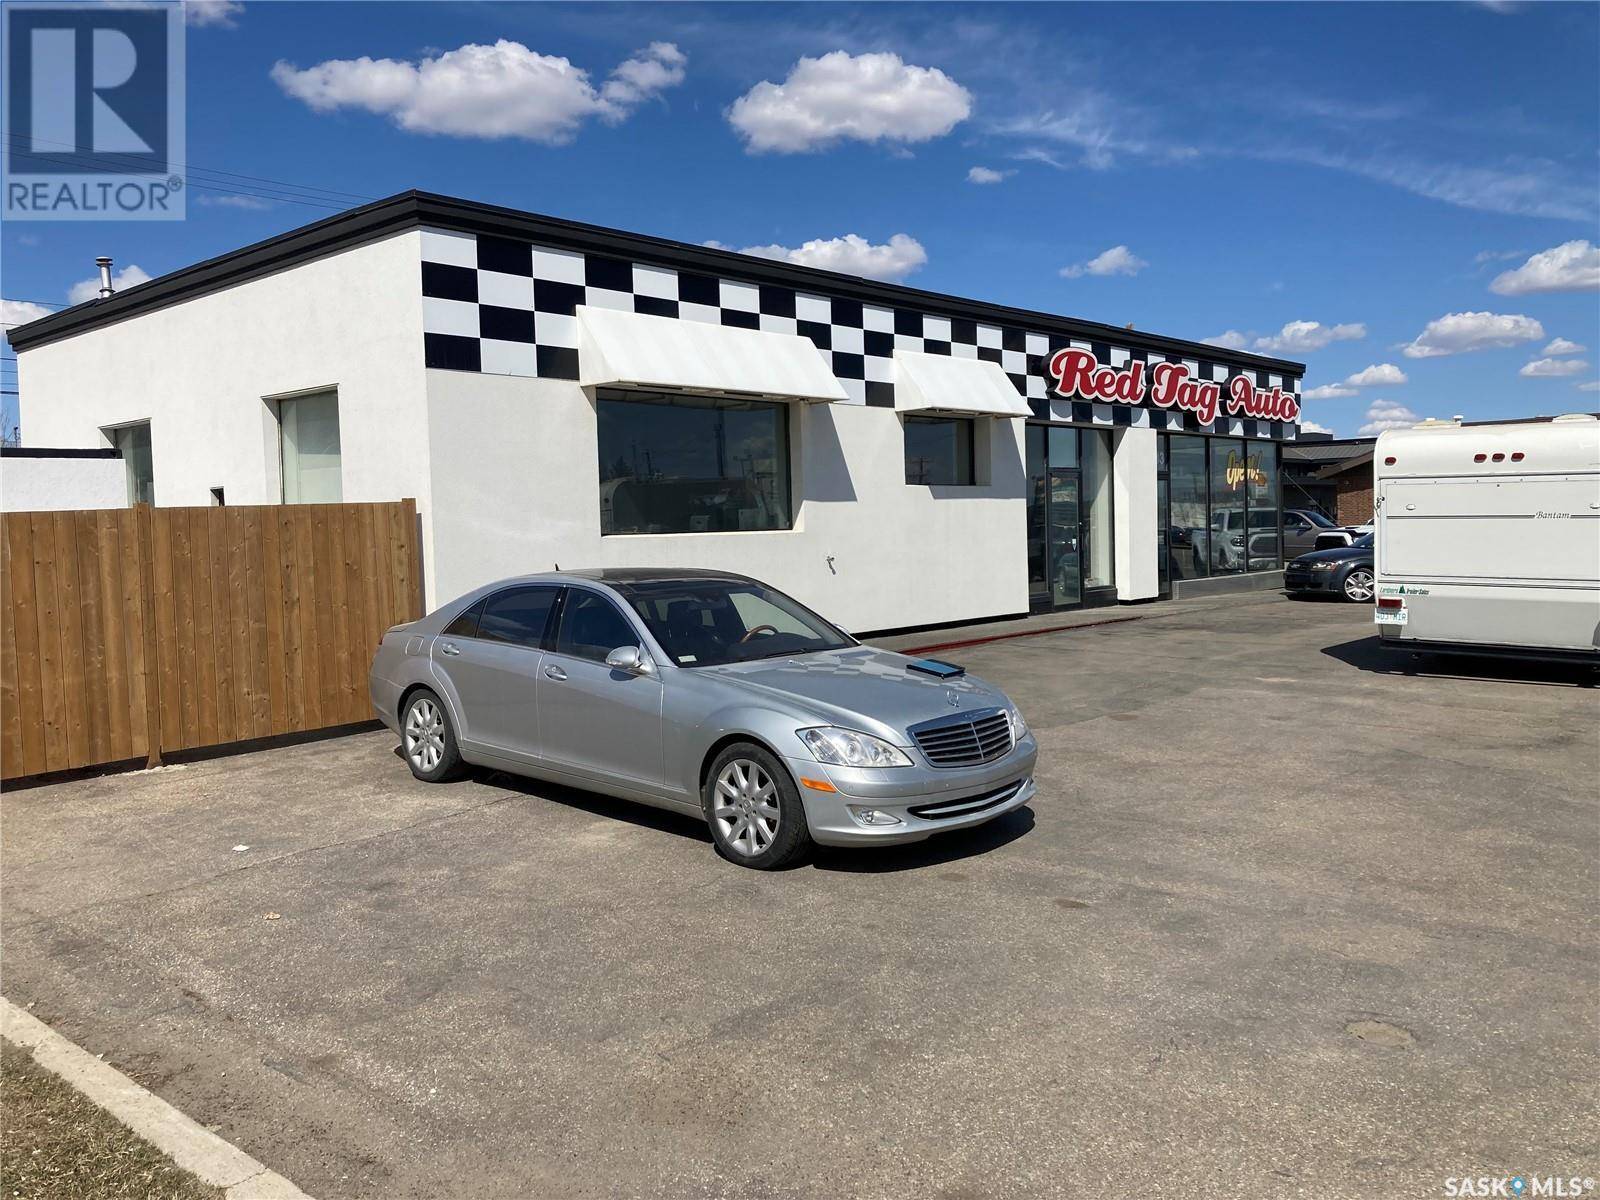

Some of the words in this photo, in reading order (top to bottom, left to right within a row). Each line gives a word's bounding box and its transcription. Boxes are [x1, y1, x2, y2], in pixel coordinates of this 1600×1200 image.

[1050, 347, 1145, 404] Red
[1152, 362, 1220, 426] Tag
[1226, 374, 1300, 422] Auto
[1535, 511, 1570, 519] Bantam
